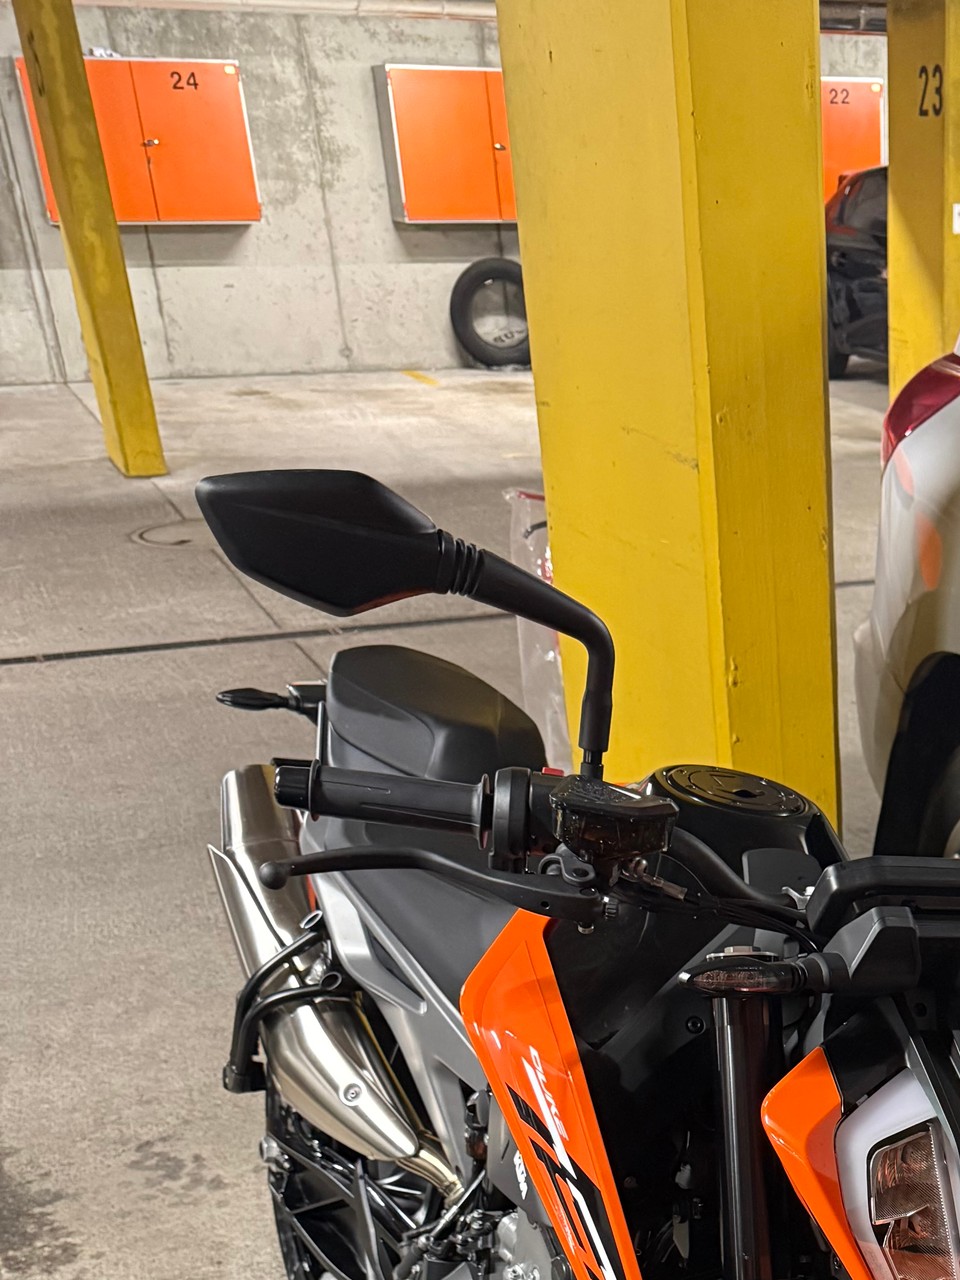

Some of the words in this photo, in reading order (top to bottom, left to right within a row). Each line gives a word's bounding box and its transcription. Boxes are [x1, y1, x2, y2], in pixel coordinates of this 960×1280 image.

[170, 71, 199, 90] 24
[829, 88, 850, 104] 22
[918, 64, 943, 117] 23
[529, 1045, 569, 1142] DUKE
